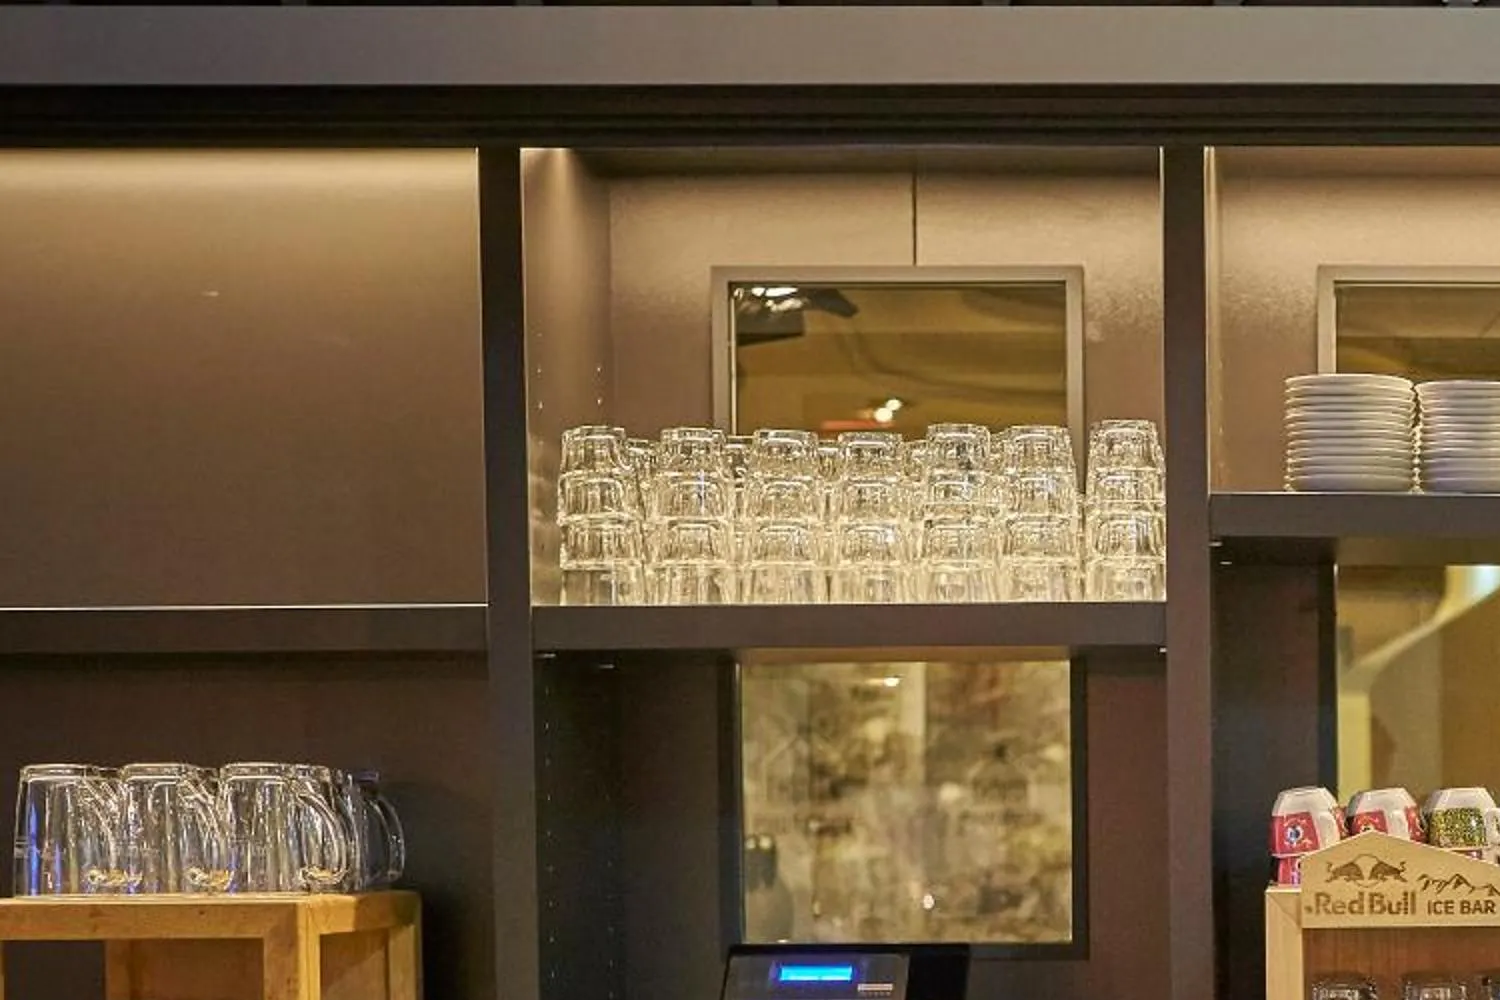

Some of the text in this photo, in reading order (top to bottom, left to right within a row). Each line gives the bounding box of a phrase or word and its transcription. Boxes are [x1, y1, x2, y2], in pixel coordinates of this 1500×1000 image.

[1314, 891, 1497, 915] Red Bull ICE BAR
